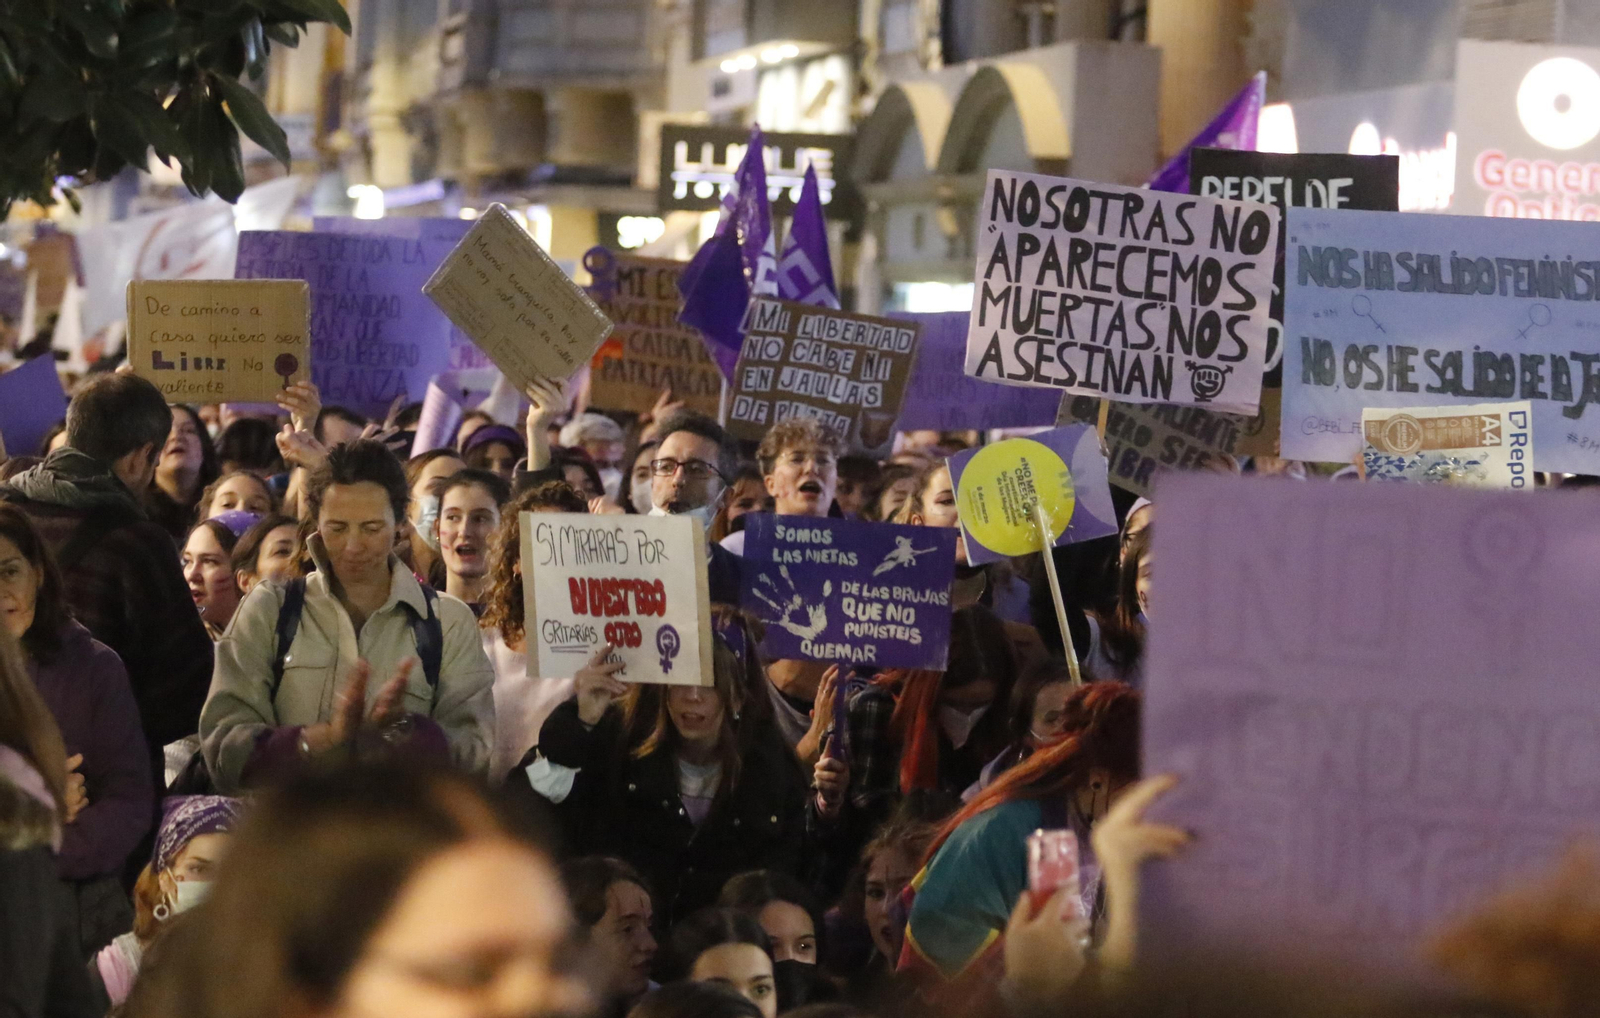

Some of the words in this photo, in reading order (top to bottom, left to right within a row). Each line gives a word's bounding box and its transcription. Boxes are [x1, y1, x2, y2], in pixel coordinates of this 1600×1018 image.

[990, 178, 1197, 245] NOSOTRAS
[1210, 204, 1271, 256] NO
[473, 235, 506, 270] Mamá
[1363, 250, 1395, 291] HA
[145, 296, 170, 316] De
[181, 302, 240, 317] camino
[249, 308, 262, 316] a
[462, 253, 474, 267] no
[497, 288, 516, 310] sola
[515, 313, 536, 331] por
[540, 330, 551, 344] la
[553, 344, 574, 366] calle
[208, 327, 267, 350] quiero
[273, 334, 302, 345] ser
[800, 316, 913, 352] LIBERTAD
[1167, 306, 1251, 363] NOS
[243, 358, 264, 371] No
[746, 339, 781, 359] NO
[792, 342, 854, 373] CABE
[863, 352, 890, 380] NI
[975, 330, 1174, 401] ASESINAN
[1343, 343, 1384, 391] OS
[1387, 345, 1419, 393] HE
[157, 378, 225, 394] valiente
[744, 368, 772, 390] EN
[780, 368, 880, 406] JAULAS
[735, 399, 768, 422] DE
[1481, 416, 1500, 446] A4
[1015, 468, 1029, 501] CREER
[634, 529, 670, 565] POR
[775, 525, 833, 544] SOMOS
[772, 548, 802, 563] LAS
[804, 549, 859, 567] NIETAS
[841, 581, 860, 596] DE
[862, 583, 890, 600] LAS
[892, 586, 949, 606] BRUJAS
[842, 597, 883, 622] QUE
[886, 603, 916, 626] NO
[844, 622, 923, 645] PUDISTEIS
[801, 640, 877, 663] QUEMAR
